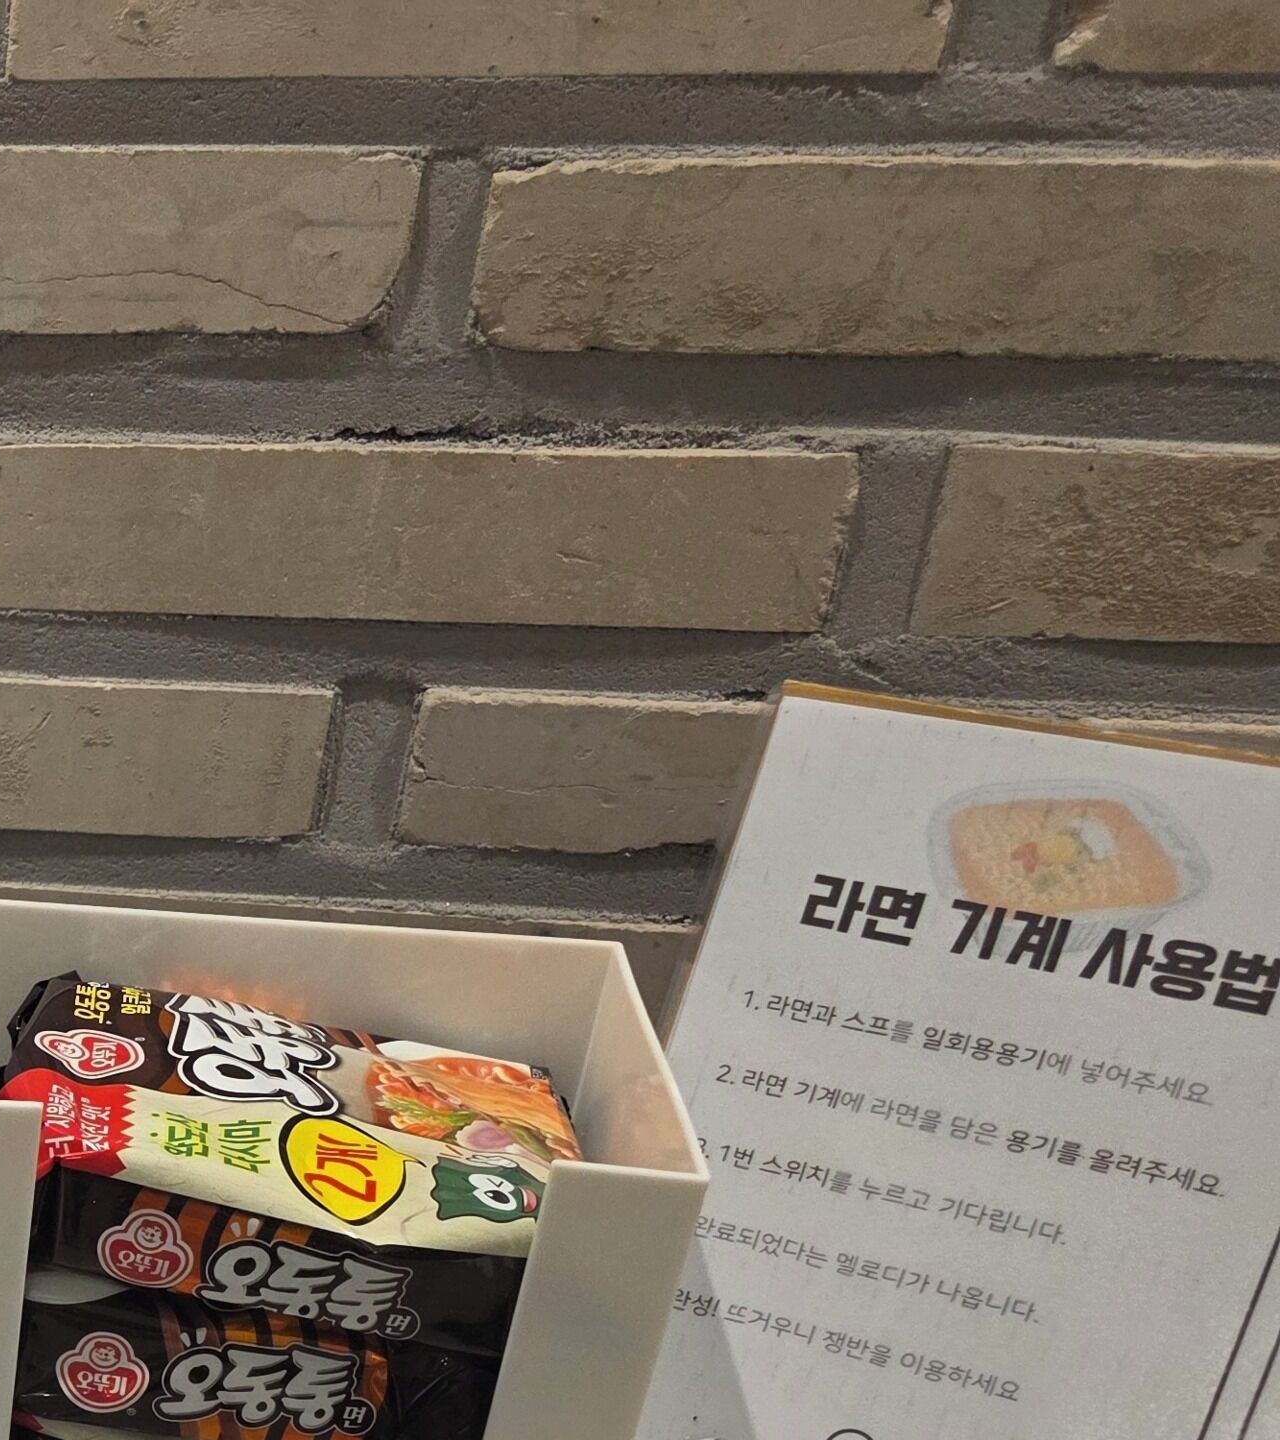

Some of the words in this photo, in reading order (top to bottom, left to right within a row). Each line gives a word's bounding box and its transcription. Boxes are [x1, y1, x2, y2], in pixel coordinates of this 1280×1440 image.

[800, 873, 927, 946] 라면
[950, 898, 1072, 973] 기계
[1080, 927, 1280, 1016] 사용법
[90, 1040, 119, 1068] 오뚜기
[743, 990, 759, 1011] 1.
[766, 994, 837, 1027] 라면과
[840, 1011, 914, 1044] 스프를
[922, 1026, 1073, 1077] 일회용용기에
[163, 1111, 209, 1158] 완도산
[217, 1119, 273, 1174] 다시마
[303, 1132, 378, 1203] 2개!
[715, 1064, 735, 1086] 2.
[741, 1069, 788, 1098] 라면
[793, 1081, 866, 1114] 기계에
[869, 1097, 942, 1133] 라면을
[949, 1115, 999, 1147] 담은
[1005, 1129, 1082, 1167] 용기를
[1088, 1148, 1225, 1198] 올려주세요.
[720, 1145, 755, 1171] 1번
[759, 1156, 853, 1195] 스위치를
[858, 1177, 931, 1211] 누르고
[938, 1198, 1066, 1246] 기다립니다.
[116, 1249, 171, 1279] 오뚜기
[694, 1215, 828, 1269] 완료되었다는
[836, 1252, 931, 1294] 멜로디가
[936, 1279, 1040, 1324] 나옵니다.
[75, 1366, 129, 1398] 오뚜기
[723, 1302, 817, 1345] 뜨거우니
[822, 1329, 892, 1368] 쟁반을
[899, 1351, 1021, 1401] 이용하세요
